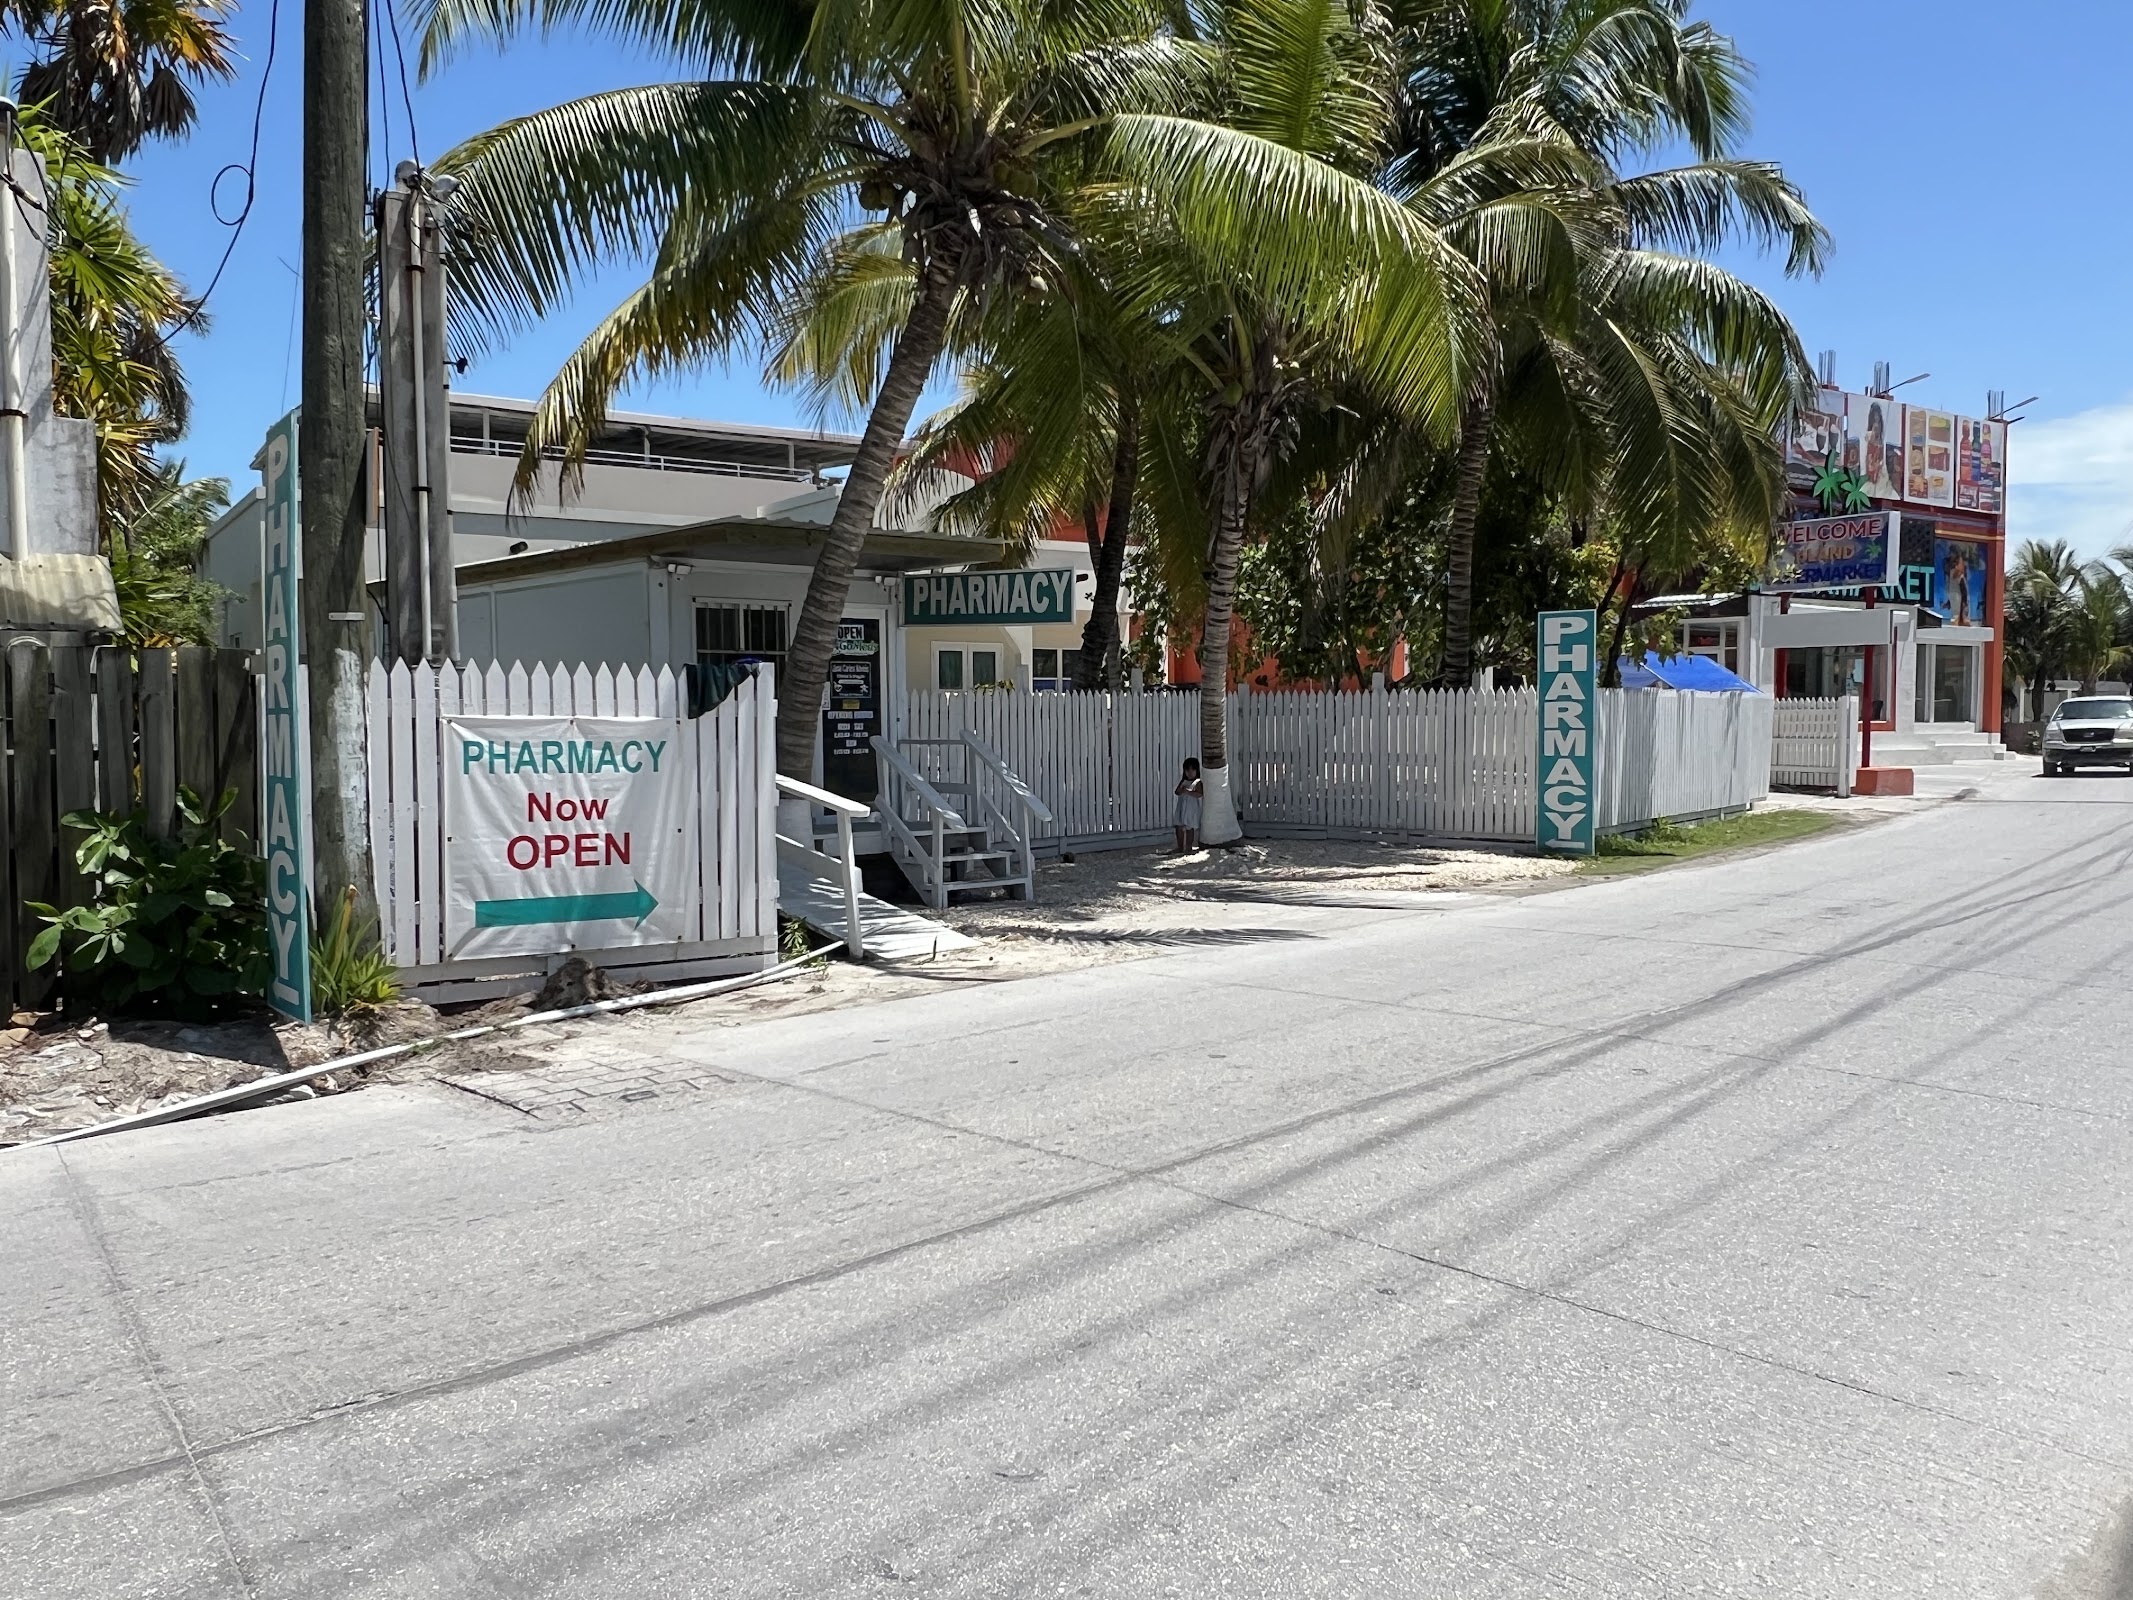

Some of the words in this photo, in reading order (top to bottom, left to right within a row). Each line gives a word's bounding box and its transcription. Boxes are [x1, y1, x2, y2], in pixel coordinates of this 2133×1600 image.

[912, 571, 1071, 616] PHARMACY
[837, 626, 863, 639] OPEN
[267, 433, 297, 981] PHARMACY
[1543, 616, 1589, 840] PHARMACY
[462, 739, 667, 775] PHARMACY
[527, 792, 610, 823] Now
[506, 831, 631, 871] OPEN
